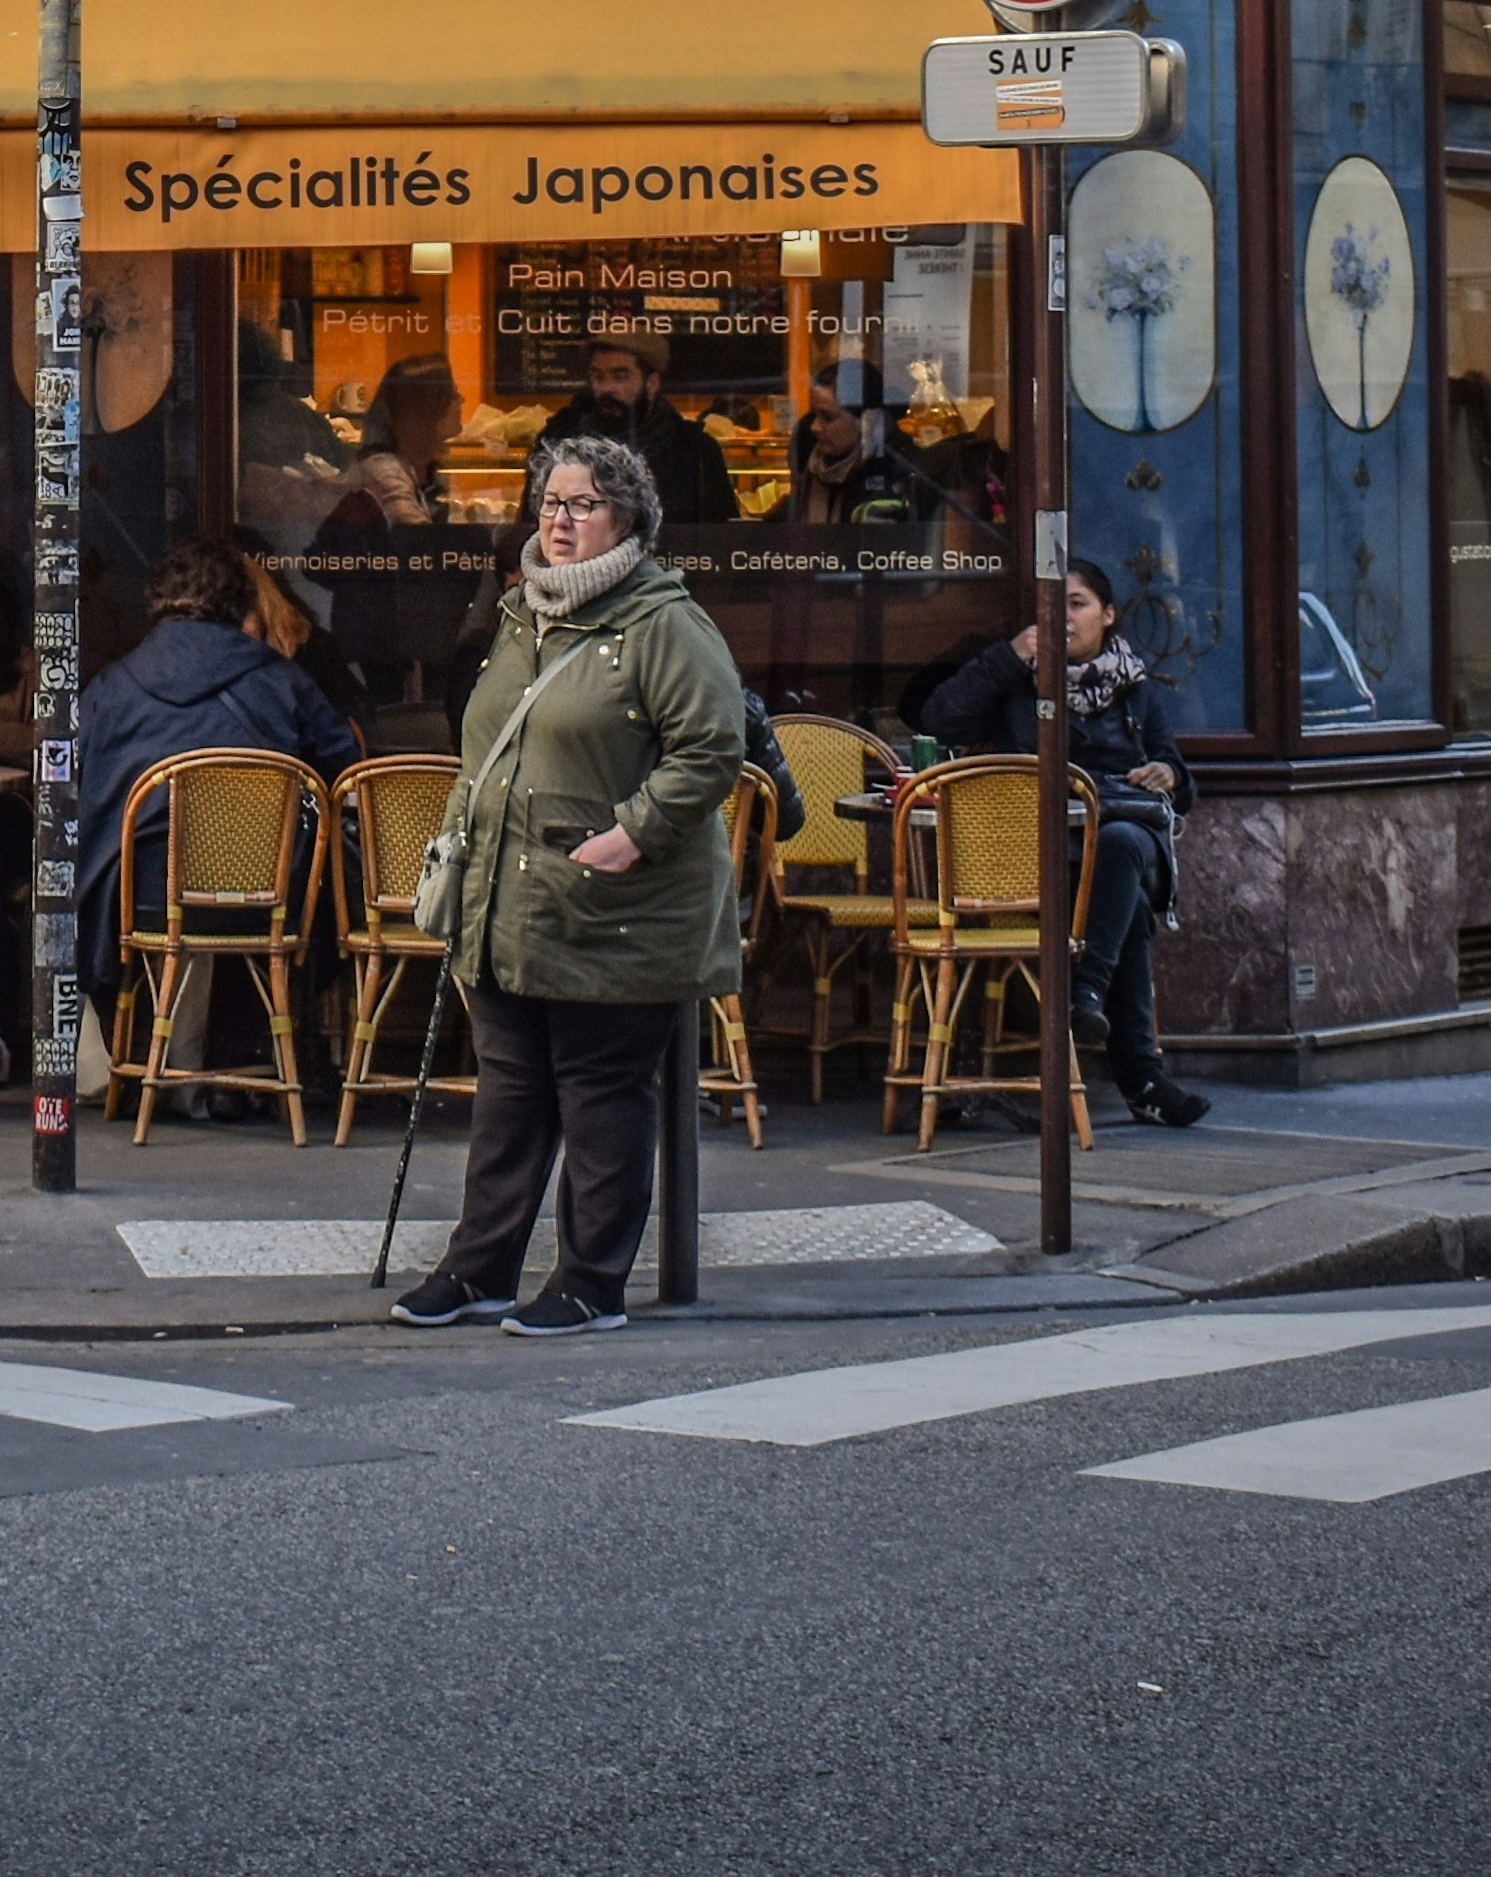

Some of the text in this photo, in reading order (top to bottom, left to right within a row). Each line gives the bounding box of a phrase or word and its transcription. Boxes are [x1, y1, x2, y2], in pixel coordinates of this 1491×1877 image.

[987, 45, 1076, 75] SAUF
[124, 150, 472, 226] Spécialités
[511, 152, 881, 215] Japonaises
[508, 264, 733, 289] Pain Maison
[323, 308, 430, 335] Pétrit
[445, 311, 482, 335] et
[497, 309, 573, 335] Cuit
[586, 310, 673, 335] dans
[690, 311, 791, 335] notre
[245, 551, 400, 571] Viennoiseries
[409, 553, 435, 571] et
[857, 551, 933, 571] Coffee
[942, 551, 1003, 574] Shop
